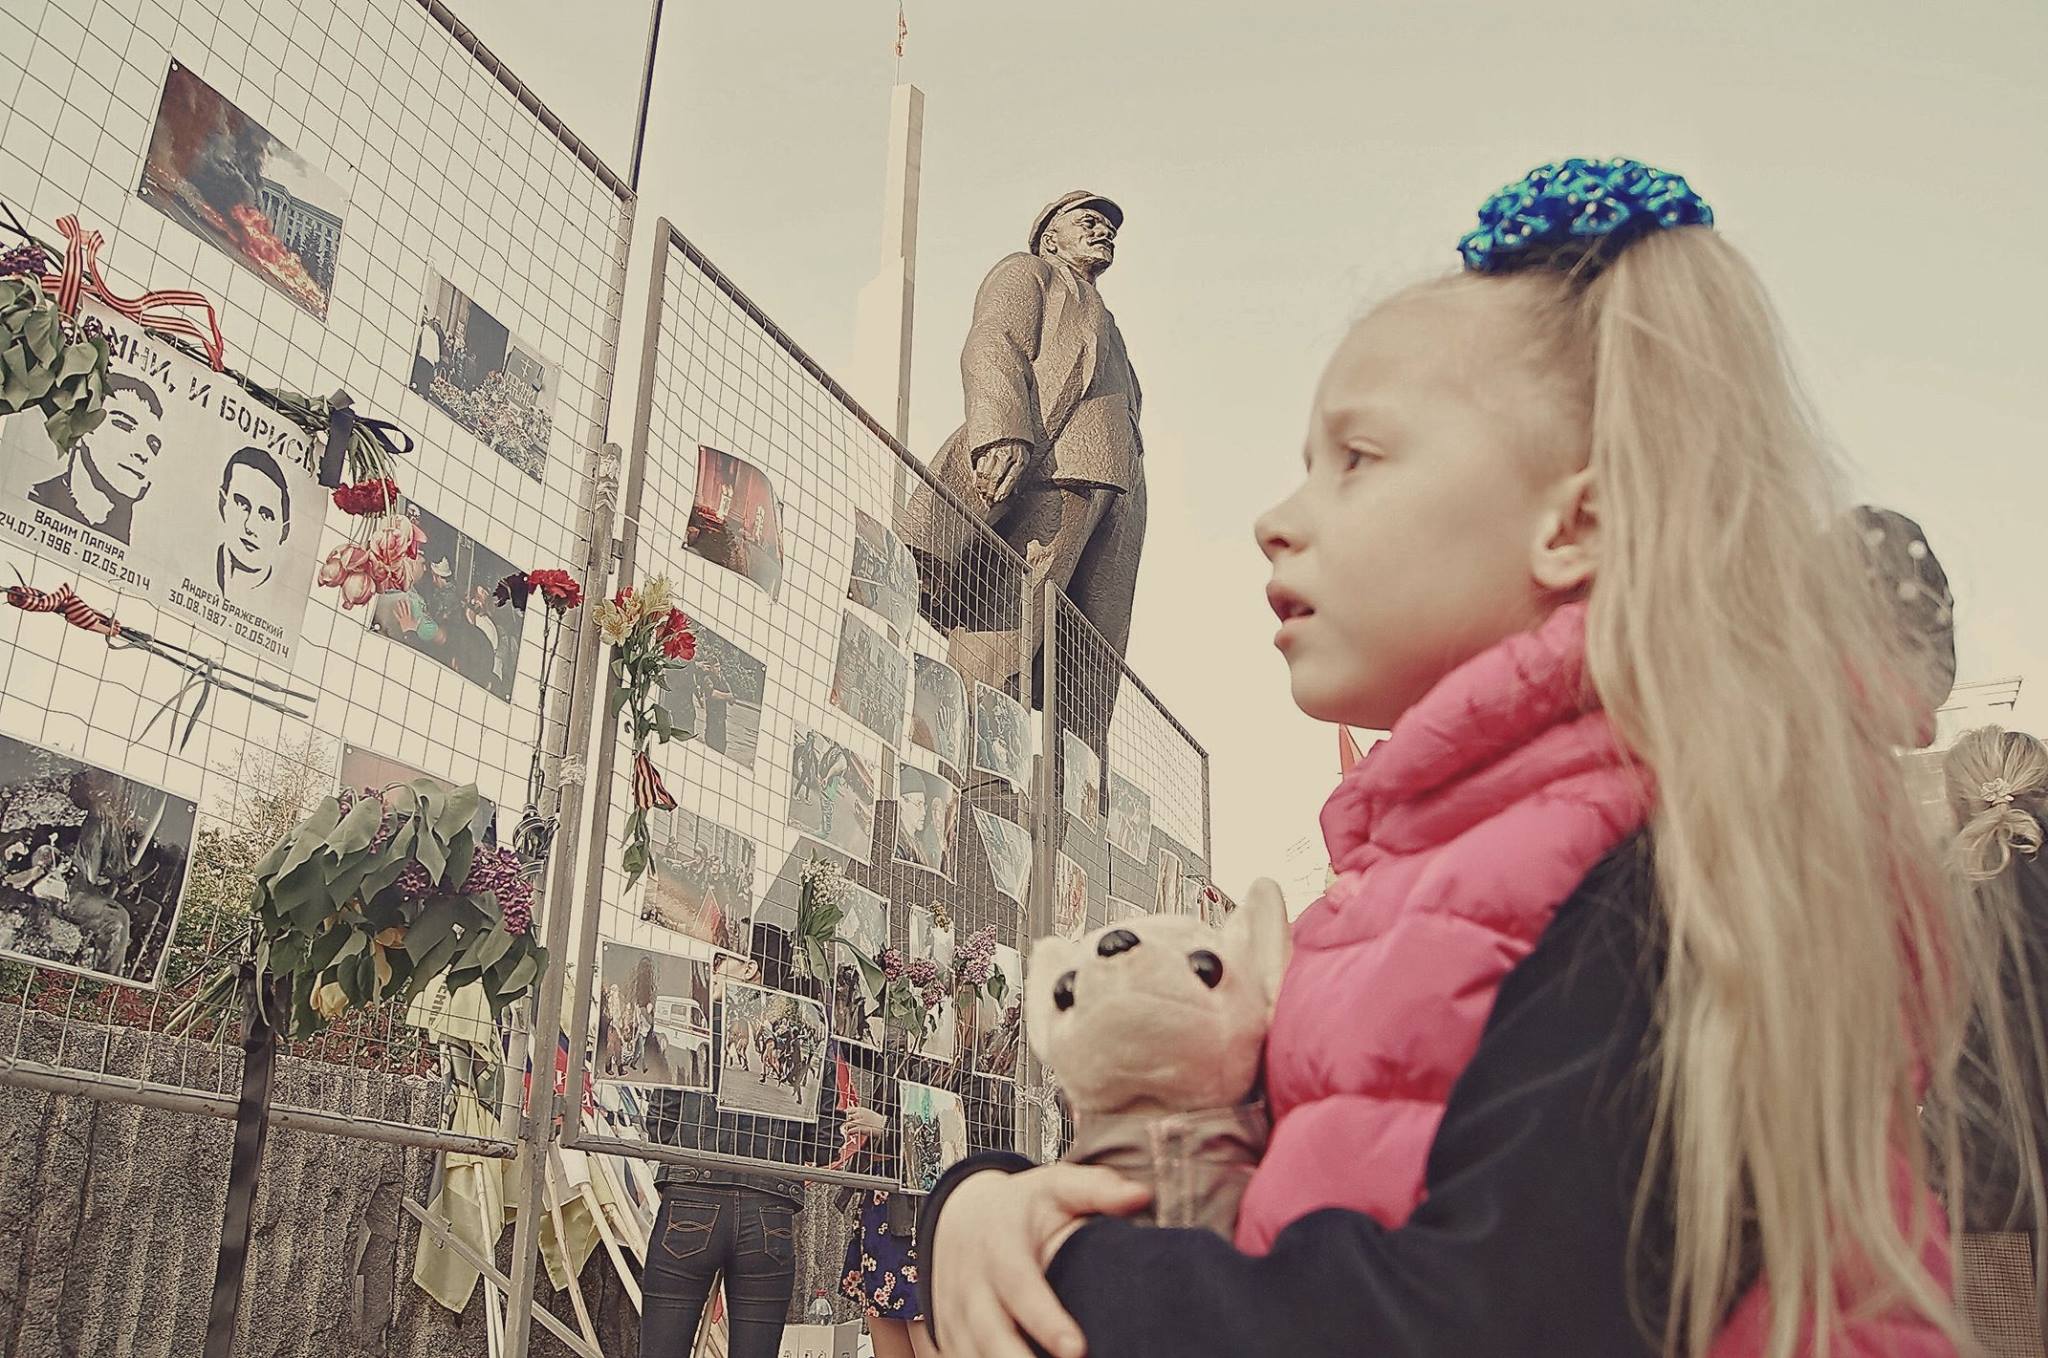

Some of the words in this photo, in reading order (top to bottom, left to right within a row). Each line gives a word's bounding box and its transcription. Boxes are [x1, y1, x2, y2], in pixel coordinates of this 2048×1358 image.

[189, 377, 211, 408] И
[0, 511, 73, 556] 24.07.1996
[82, 549, 151, 591] 02.05.2014
[168, 589, 227, 627] 30.08.1987
[234, 622, 290, 658] 02.05.2014
